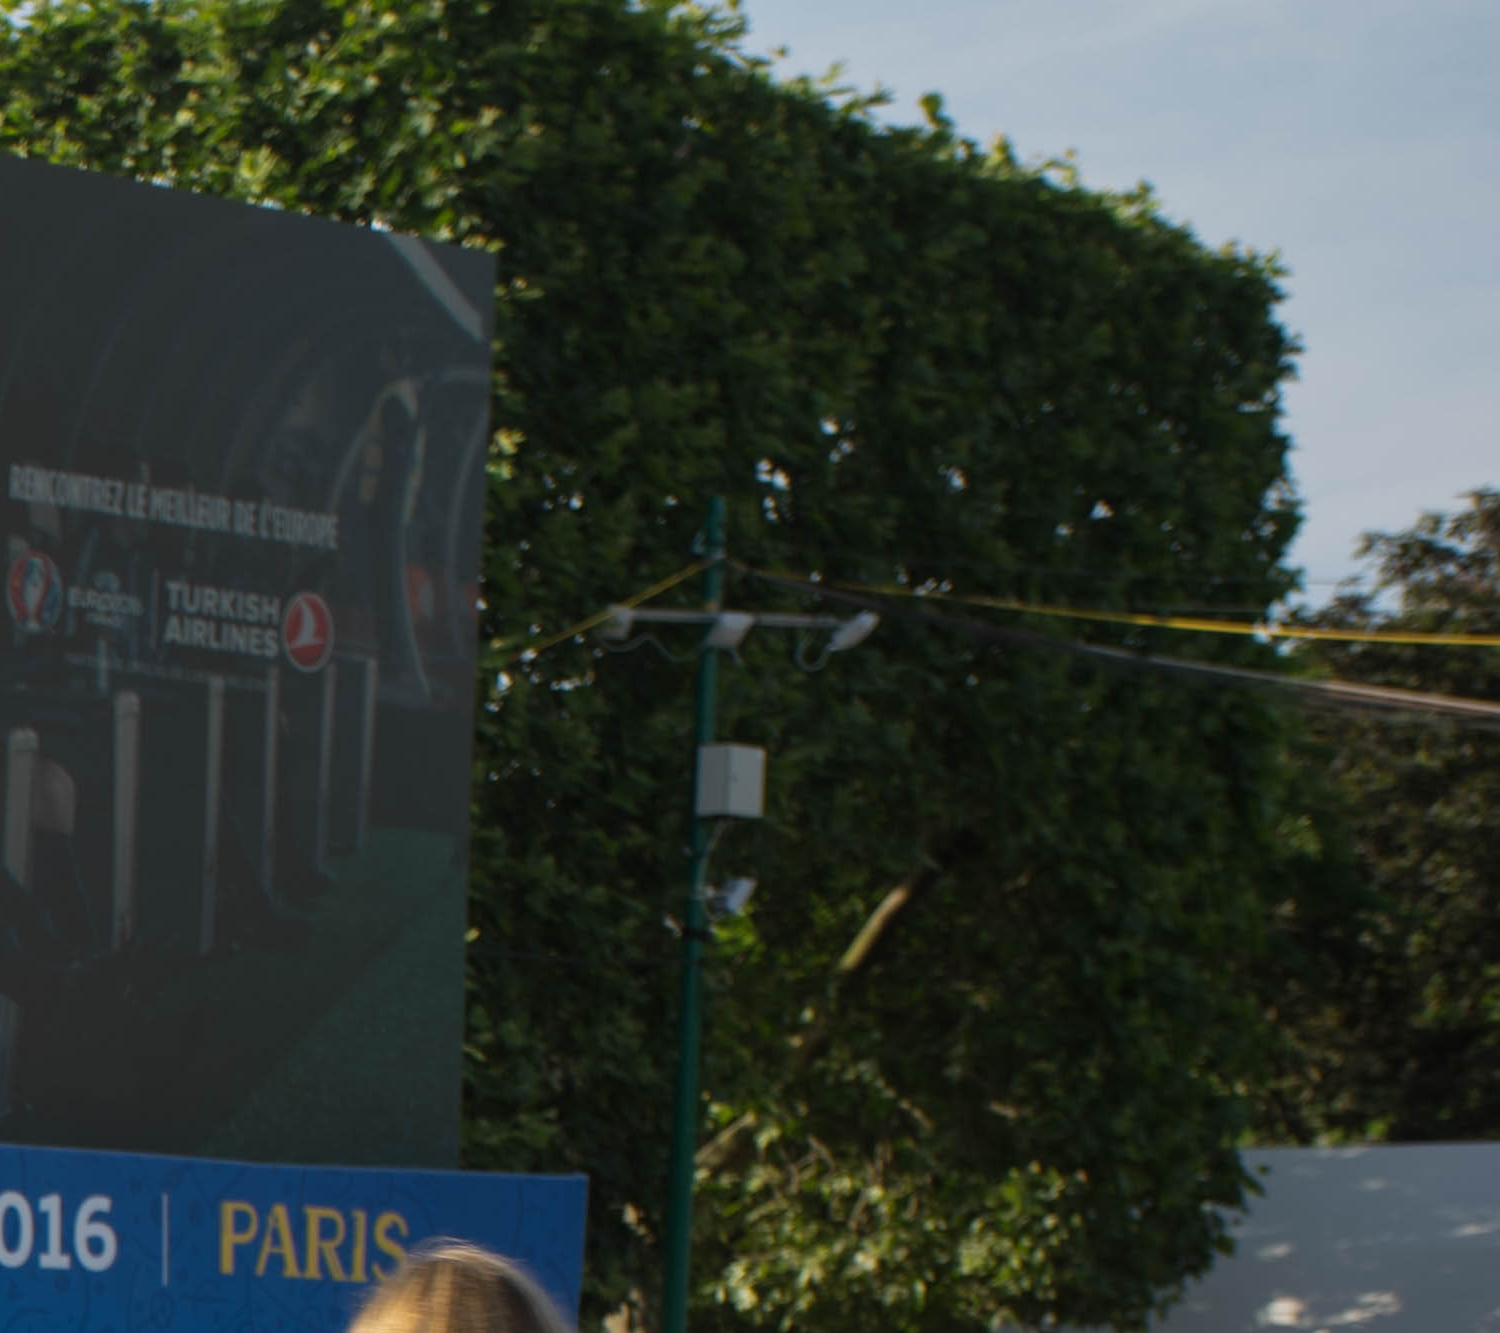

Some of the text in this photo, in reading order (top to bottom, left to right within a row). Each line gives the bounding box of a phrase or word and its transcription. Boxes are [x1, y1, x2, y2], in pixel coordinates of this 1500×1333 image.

[8, 463, 338, 552] RENCONTREZ LE MEILLEUR DE L'EUROPE
[166, 580, 279, 626] TURKISH
[164, 615, 279, 658] AIRLINES
[219, 1199, 409, 1283] PARIS
